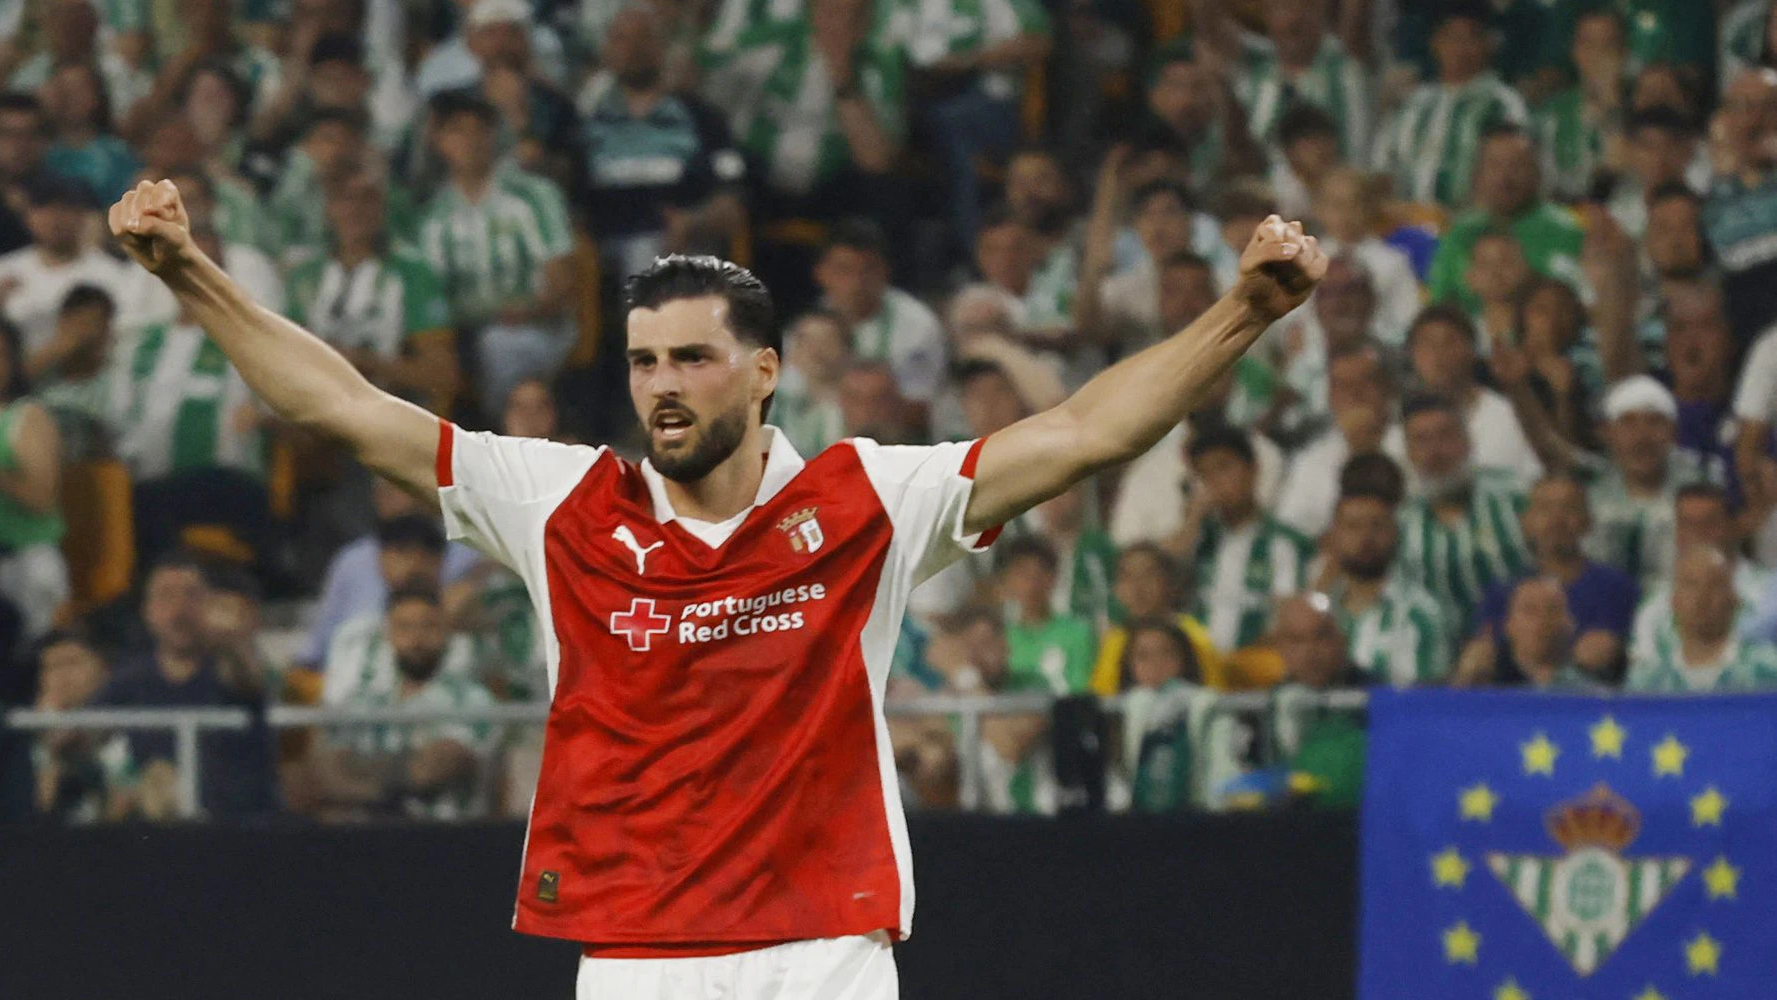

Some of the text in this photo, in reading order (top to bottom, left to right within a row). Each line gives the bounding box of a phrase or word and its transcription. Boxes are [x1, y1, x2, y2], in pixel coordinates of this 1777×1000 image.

[680, 582, 826, 620] Portuguese
[678, 610, 804, 644] Red Cross
